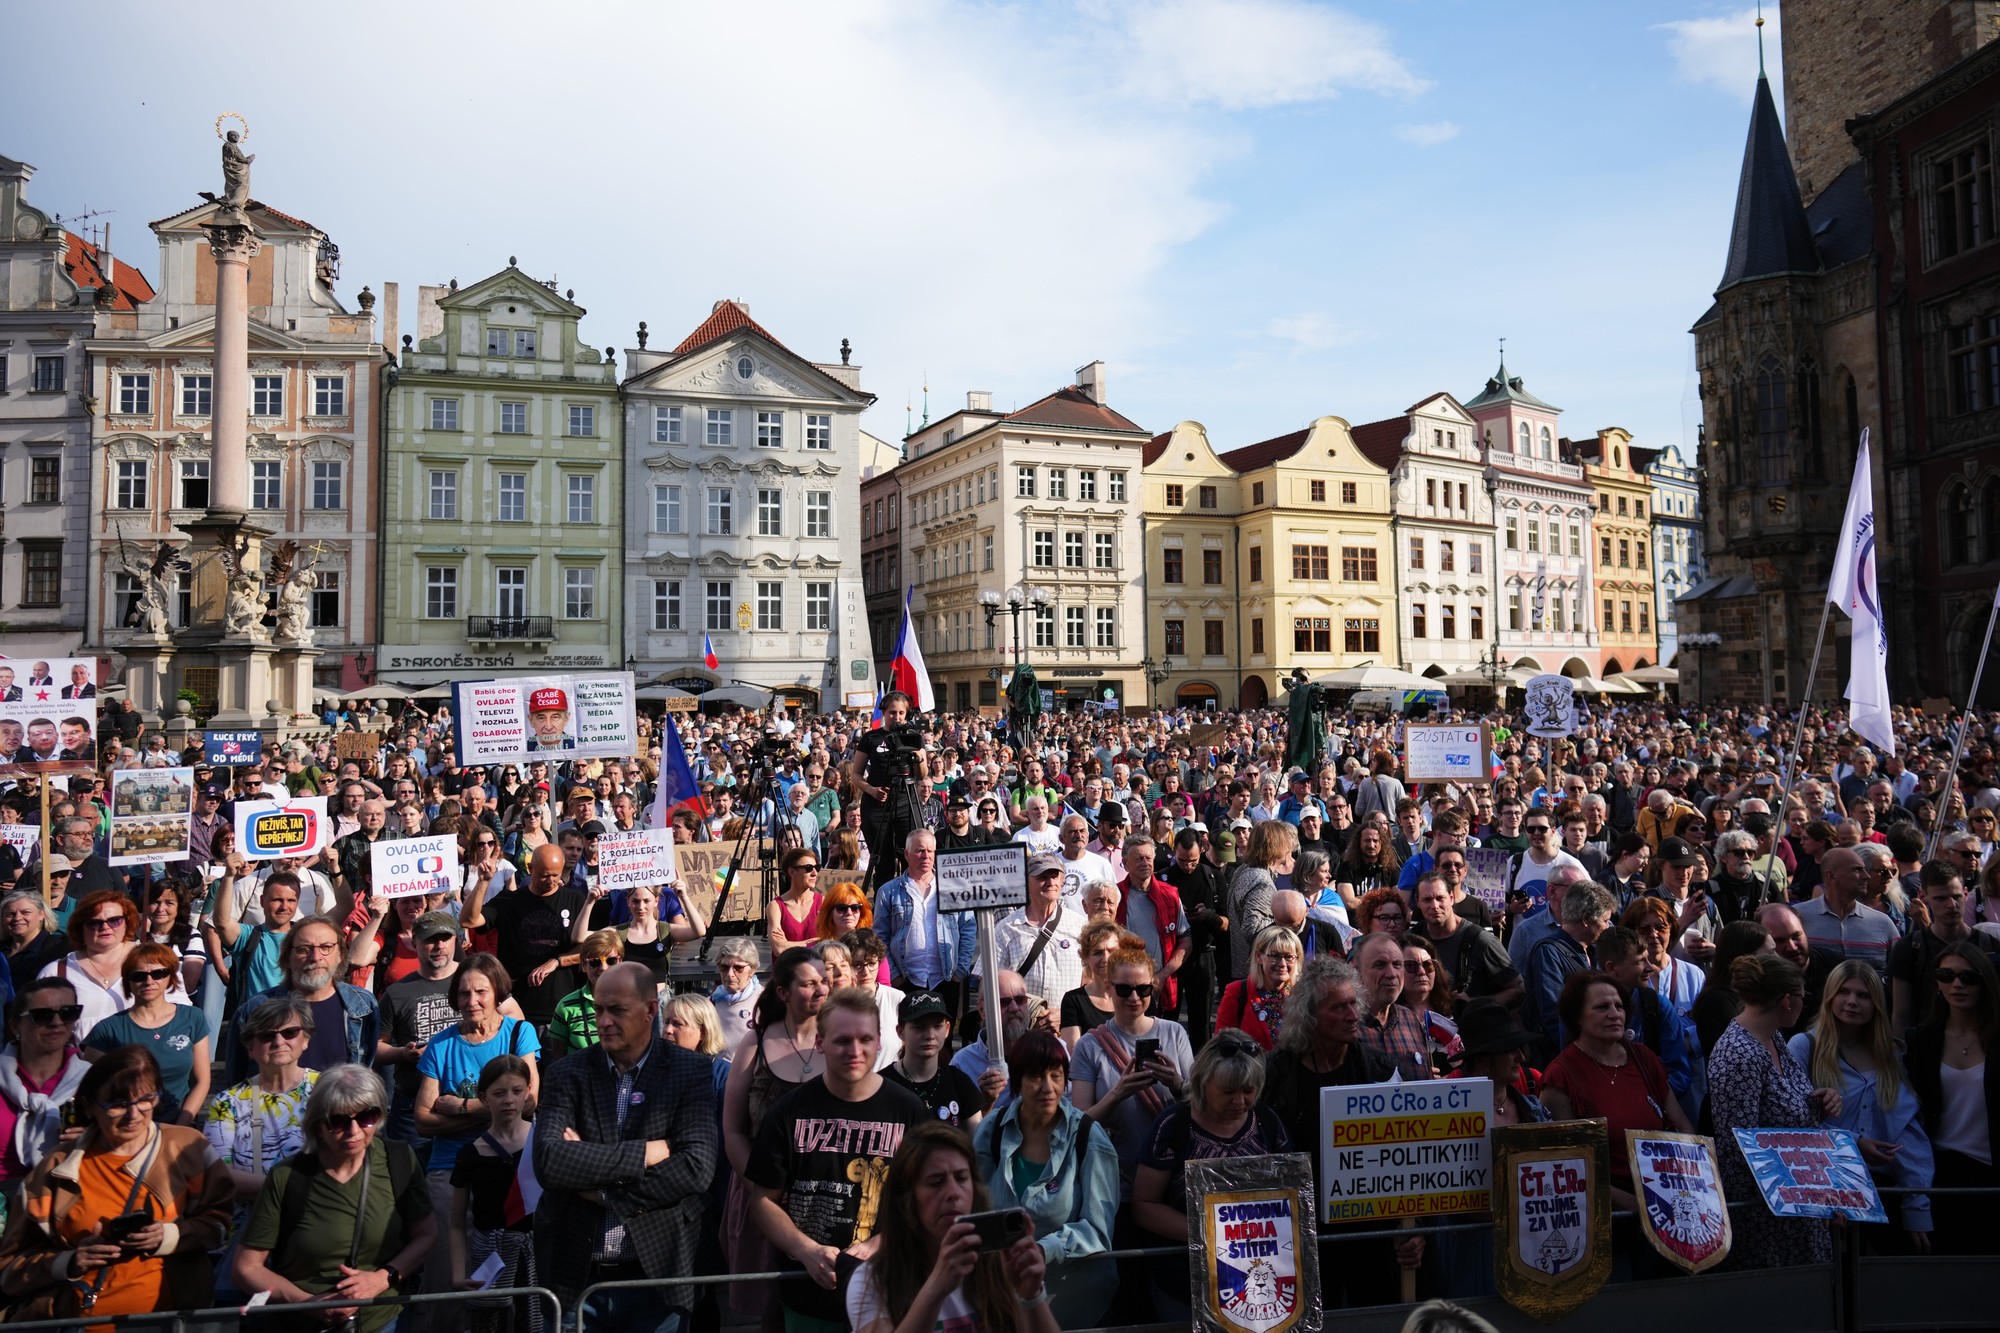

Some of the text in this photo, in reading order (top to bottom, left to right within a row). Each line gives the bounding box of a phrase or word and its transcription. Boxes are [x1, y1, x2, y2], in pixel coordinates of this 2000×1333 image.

[847, 591, 856, 650] HOTEL
[1295, 619, 1329, 629] CAFE
[1345, 619, 1378, 629] CAFE
[391, 652, 514, 667] STAROMĚSTSKÁ
[536, 690, 559, 699] SLABÉ
[537, 698, 559, 706] ČESKO
[479, 708, 514, 716] TELEVIZI
[587, 709, 614, 717] MÉDIA
[482, 718, 519, 726] ROZHLAS
[600, 723, 620, 731] HDP
[213, 732, 258, 741] RUCE PRYČ
[472, 728, 523, 737] OSLABOVAT
[212, 752, 255, 763] OD MÉDIÍ
[259, 816, 304, 831] NEŽIVÍŠ, TAK
[259, 831, 304, 845] NEPŘEPÍNEJ!
[386, 839, 444, 856] OVLADAČ
[601, 846, 664, 860] S ROZHLEDEM
[941, 853, 987, 865] závislými
[391, 864, 409, 875] OD
[601, 869, 670, 885] S CENZUROU
[942, 864, 1017, 879] chtějí ovlivnit
[383, 876, 450, 894] NEDÁME!!!
[950, 885, 1018, 904] volby...
[1346, 1085, 1471, 1115] PRO ČRo a ČT
[1334, 1118, 1430, 1144] POPLATKY
[1447, 1115, 1486, 1136] ANO
[1755, 1131, 1836, 1150] SVOBODNÁ
[1641, 1141, 1707, 1161] SVOBODNÁ
[1779, 1147, 1834, 1168] MÉDIA
[1339, 1151, 1364, 1170] NE
[1650, 1157, 1700, 1177] MÉDIA
[1330, 1166, 1487, 1197] A JEJICH PIKOLÍKY
[1520, 1166, 1545, 1198] ČT
[1553, 1163, 1586, 1195] ČRo
[1659, 1173, 1709, 1194] ŠTÍTEM
[1218, 1199, 1292, 1223] SVOBODNÁ
[1329, 1191, 1489, 1219] MÉDIA VLÁDĚ NEDÁME
[1524, 1195, 1577, 1216] STOJÍME
[1224, 1219, 1278, 1241] MÉDIA
[1528, 1210, 1580, 1233] ZA VÁMI
[1647, 1203, 1724, 1246] DEMOKRACIE
[1228, 1238, 1279, 1259] ŠTÍTEM
[1219, 1283, 1295, 1321] DEMOKRACIE
